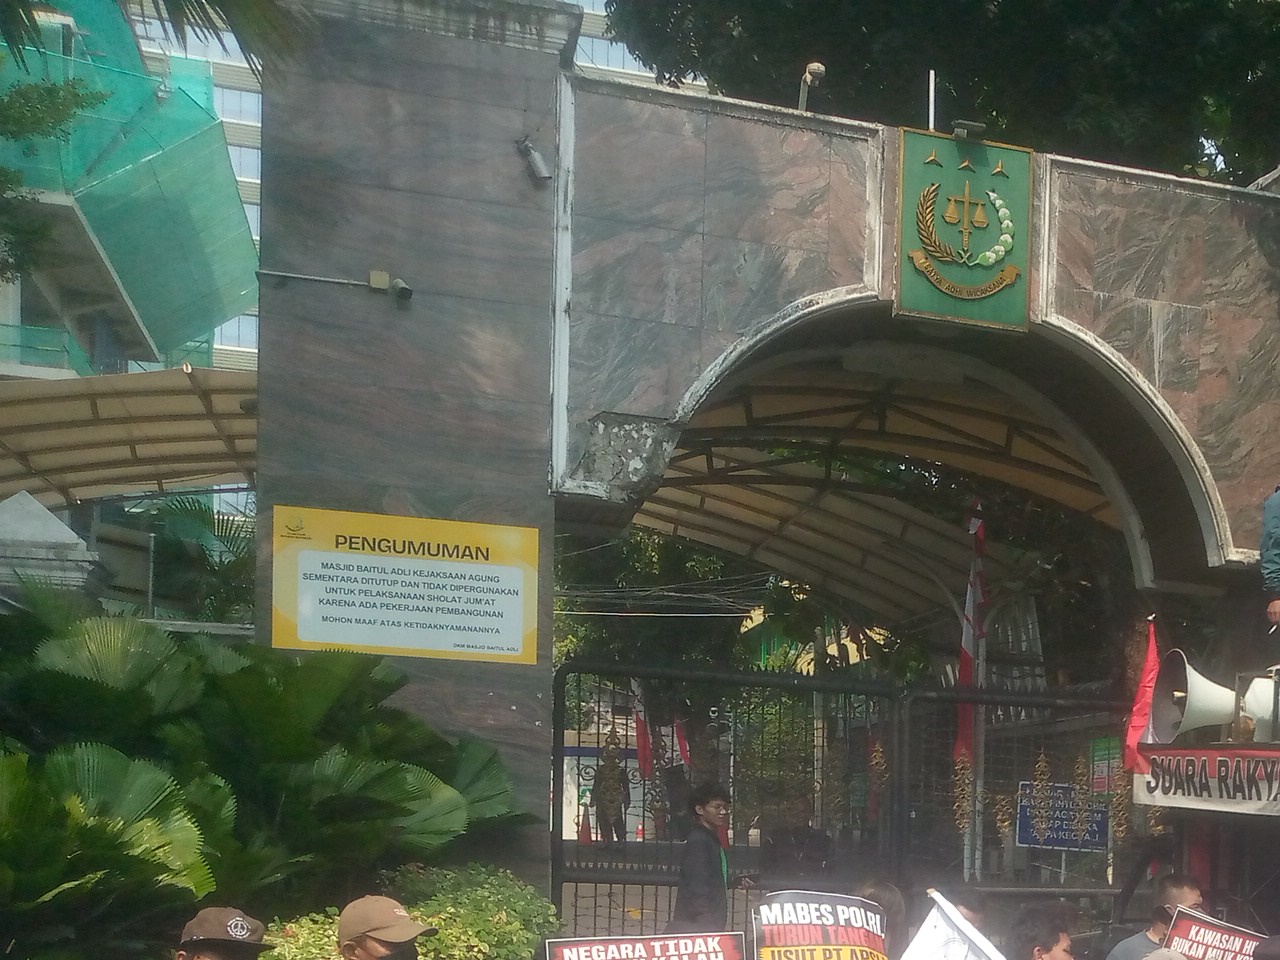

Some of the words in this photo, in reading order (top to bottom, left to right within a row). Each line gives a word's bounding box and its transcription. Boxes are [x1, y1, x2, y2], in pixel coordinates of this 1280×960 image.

[335, 534, 490, 561] PENGUMUMAN
[321, 562, 355, 572] MASJID
[357, 564, 386, 574] BAITUL
[388, 566, 411, 576] ADLI
[413, 568, 466, 580] KEJAKSAAN
[468, 573, 500, 583] AGUNG
[302, 572, 359, 584] SEMENTARA
[361, 576, 399, 588] DITUTUP
[400, 579, 420, 589] DAN
[422, 581, 448, 591] TIDAK
[450, 583, 519, 597] DIPERGUNAKAN
[325, 586, 357, 596] UNTUK
[358, 588, 425, 601] PELAKSANAAN
[426, 593, 462, 604] SHOLAT
[463, 596, 496, 606] JUM'AT
[318, 598, 357, 609] KARENA
[358, 601, 378, 610] ADA
[380, 602, 434, 614] PEKERJAAN
[435, 606, 504, 619] PEMBANGUNAN
[321, 615, 353, 625] MOHON
[354, 617, 379, 627] MAAF
[380, 619, 402, 628] ATAS
[404, 621, 500, 635] KETIDAKNYAMANANNYA
[1146, 755, 1212, 799] SUARA
[759, 902, 834, 925] MABES
[836, 904, 886, 939] POLRI,
[762, 924, 823, 946] TURUN
[1188, 925, 1243, 952] KAWASAN
[650, 936, 722, 957] TIDAK
[1171, 936, 1205, 959] BUKAN
